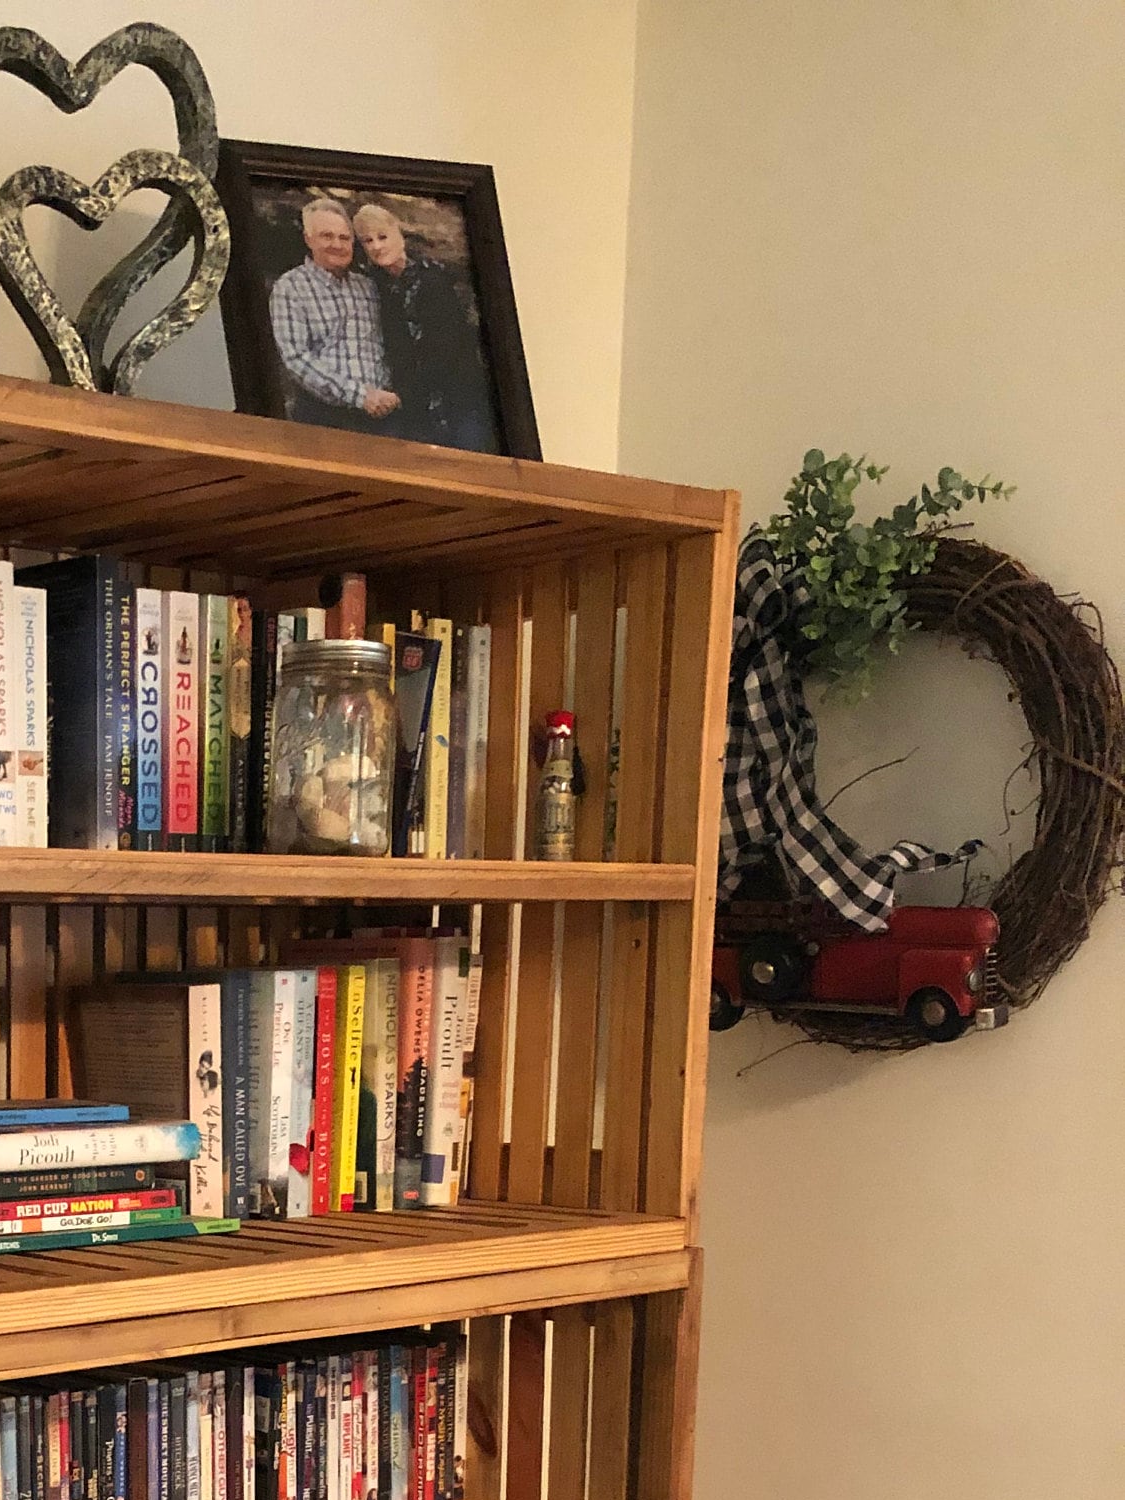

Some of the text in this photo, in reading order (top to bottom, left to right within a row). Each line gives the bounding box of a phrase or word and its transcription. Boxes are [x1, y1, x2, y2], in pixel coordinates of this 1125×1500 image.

[103, 577, 114, 817] THE ORPHAN'S TALE PAM JENOFF
[120, 596, 131, 785] THE PERFECT STRANGER
[25, 620, 36, 827] NICHOLAS SPARKS SEE ME
[175, 672, 191, 823] REACHED
[208, 674, 223, 819] MATCHED
[282, 1021, 292, 1045] ONE
[350, 976, 364, 1061] UnSelfie
[385, 974, 398, 1065] NICHOLAS
[413, 966, 426, 1054] DELIA OWENS
[440, 996, 459, 1070] Picoult
[316, 1033, 332, 1184] BOYS BOAT
[384, 1072, 396, 1130] SPARKS
[416, 1029, 432, 1137] CRAWDADS SING
[32, 1134, 60, 1148] Jodi
[235, 1076, 246, 1188] A MAN CALLED OVE
[270, 1095, 281, 1157] SCOTTOLINE
[279, 1115, 289, 1137] LISA
[19, 1147, 75, 1165] Picoult
[16, 1203, 41, 1217] RED
[44, 1202, 68, 1216] CUP
[70, 1199, 113, 1213] NATION
[97, 1214, 113, 1224] Go!
[91, 1232, 102, 1243] Dr.
[105, 1438, 115, 1475] PIRATES
[161, 1420, 169, 1457] SMOKY
[285, 1428, 296, 1458] ugly
[305, 1415, 315, 1452] PURSUIT
[342, 1412, 351, 1459] AIRPLANE!
[382, 1420, 390, 1463] EXPRESS
[392, 1416, 401, 1458] SHREK
[174, 1436, 183, 1490] HITCHCOCK
